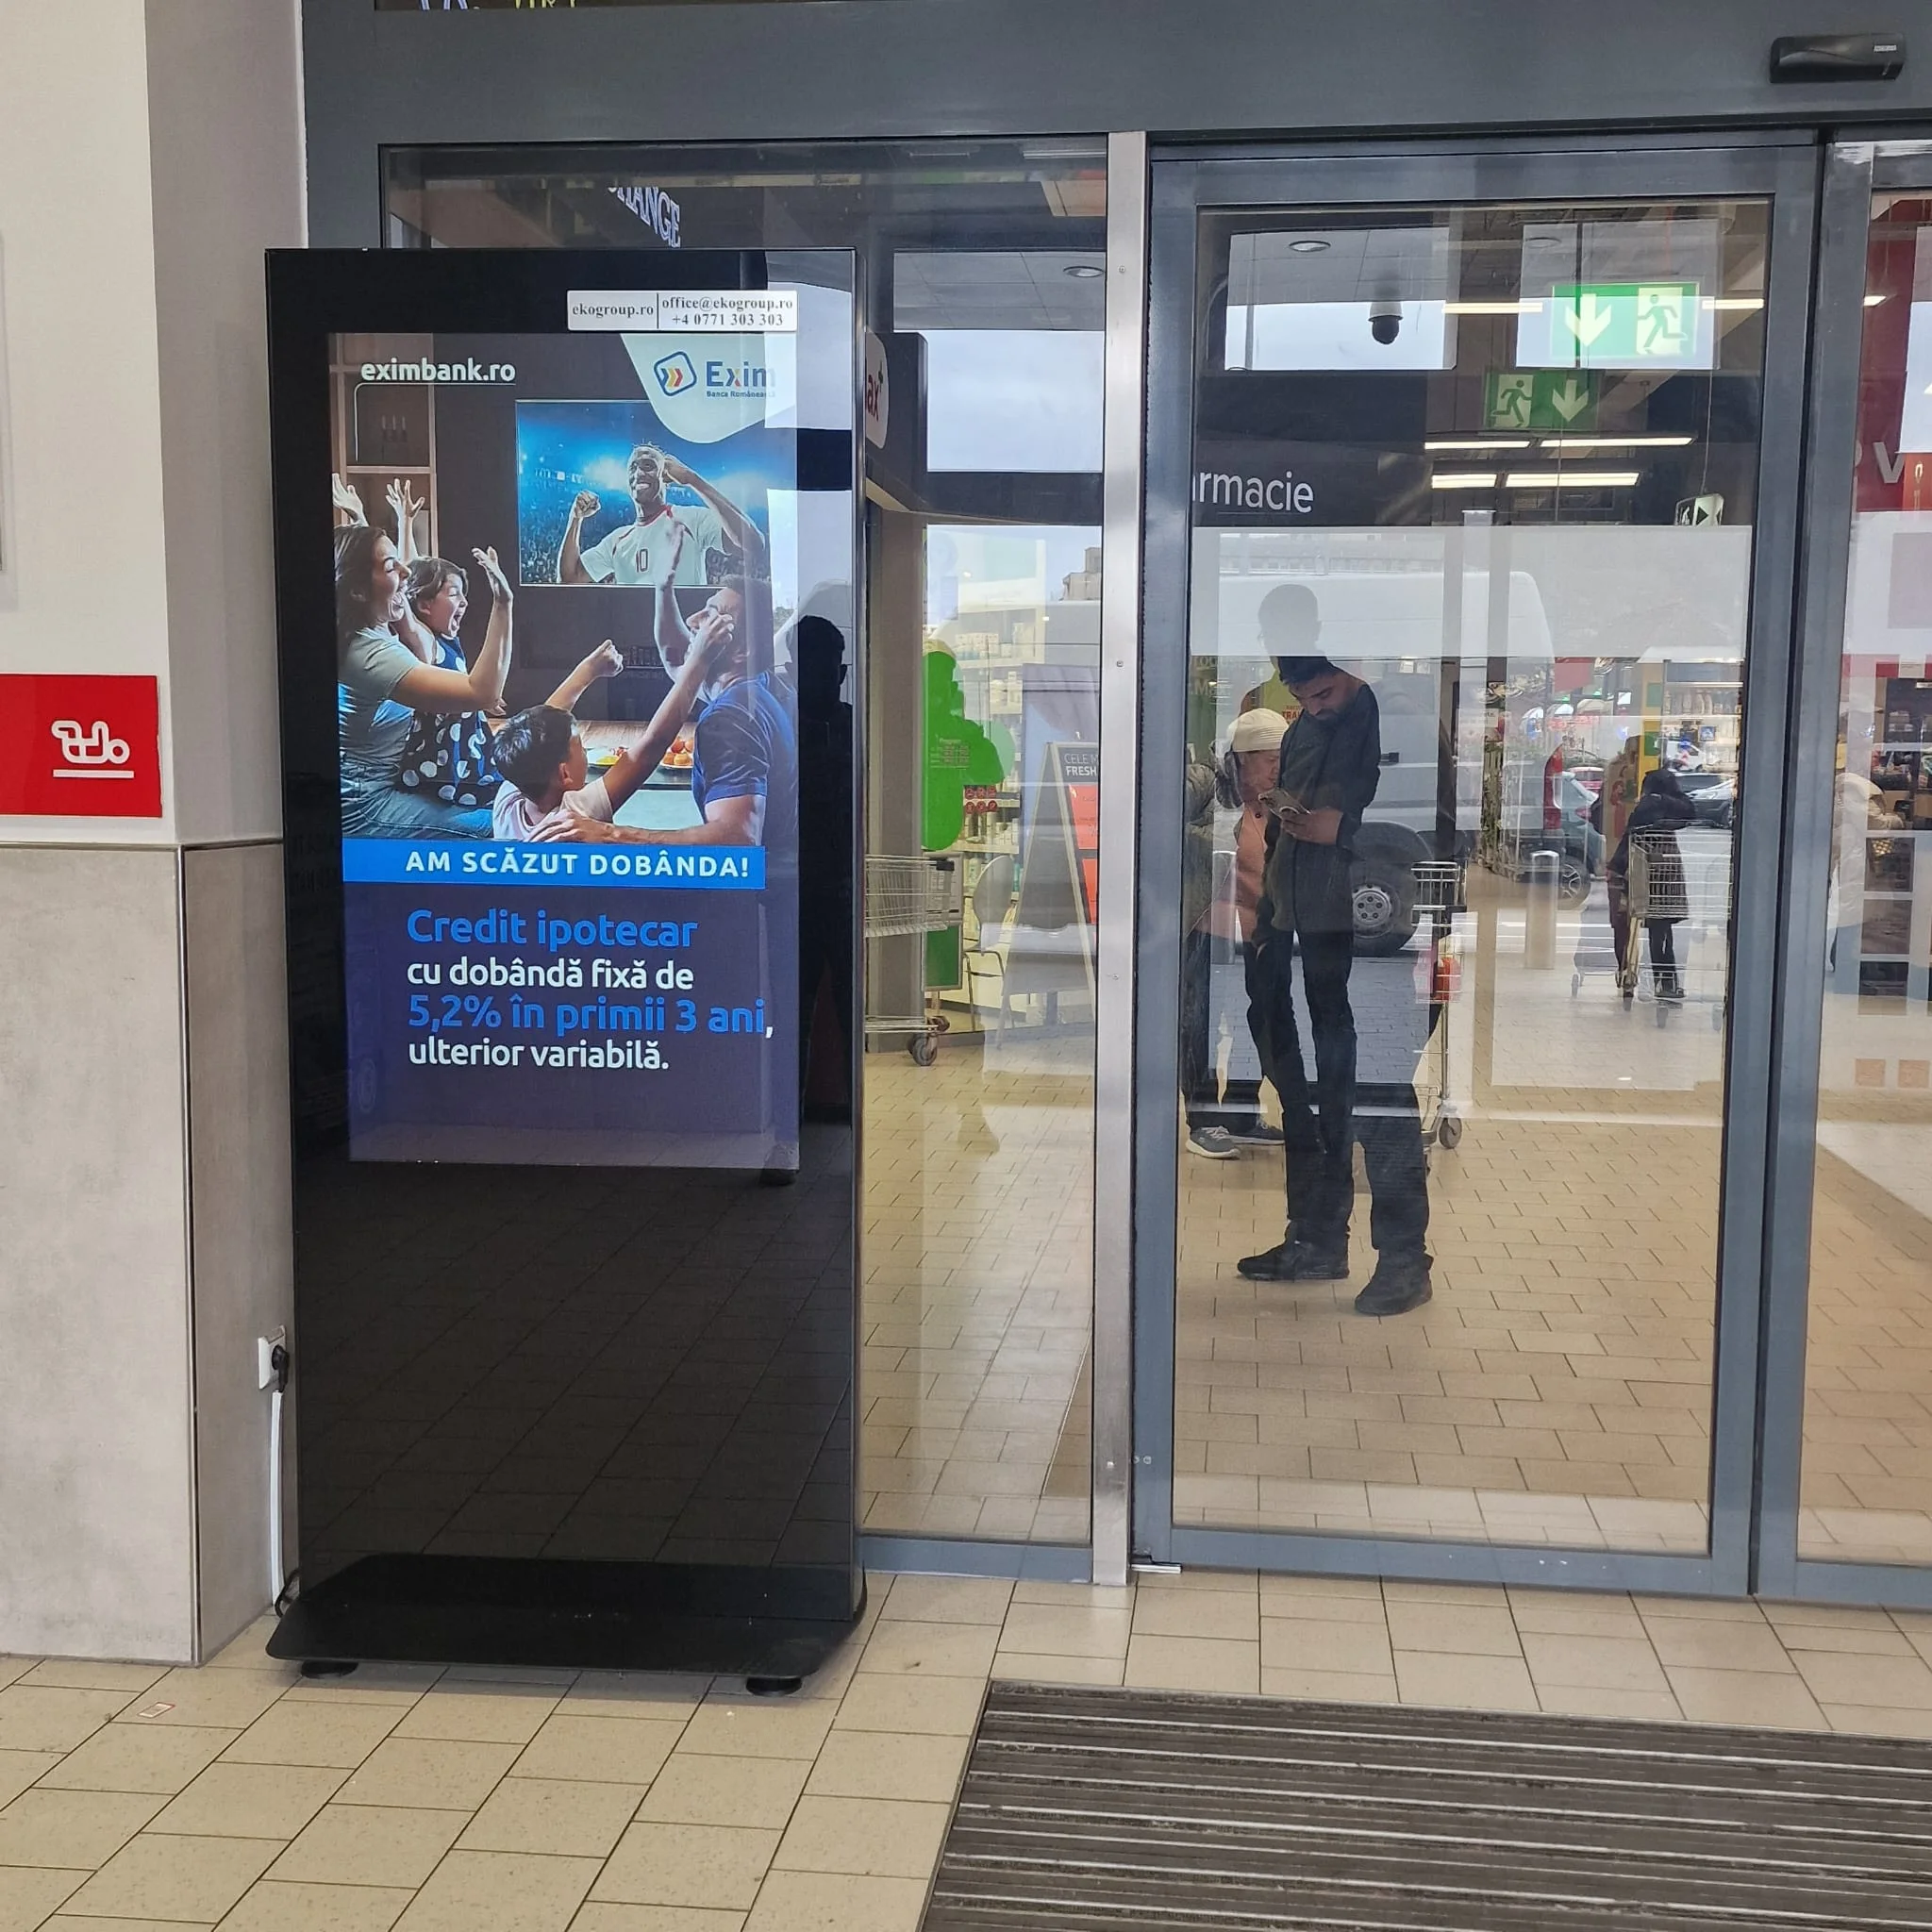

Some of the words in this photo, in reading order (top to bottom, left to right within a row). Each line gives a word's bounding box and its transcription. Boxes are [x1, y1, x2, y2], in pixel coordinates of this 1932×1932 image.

[572, 302, 654, 317] ekogroup.ro
[661, 296, 793, 311] office@ekogroup.ro
[672, 314, 690, 325] +4
[694, 313, 725, 325] 0771
[730, 313, 755, 325] 303
[758, 313, 784, 325] 303
[360, 357, 516, 382] eximbank.ro
[1192, 471, 1314, 513] rmacie
[1066, 765, 1097, 776] FRESH
[406, 851, 451, 872] AM
[462, 847, 578, 874] SCĂZUT
[590, 850, 748, 877] DOBÂNDA!
[408, 908, 527, 944] Credit
[537, 909, 698, 952] ipotecar
[408, 962, 441, 985] cu
[449, 956, 583, 988] dobândă
[591, 958, 647, 989] fixă
[656, 960, 693, 990] de
[408, 993, 502, 1033] 5,2%
[509, 993, 545, 1028] în
[557, 995, 666, 1037] primii
[675, 999, 698, 1032] 3
[708, 998, 774, 1039] ani,
[408, 1036, 525, 1066] ulterior
[530, 1039, 669, 1070] variabilă.
